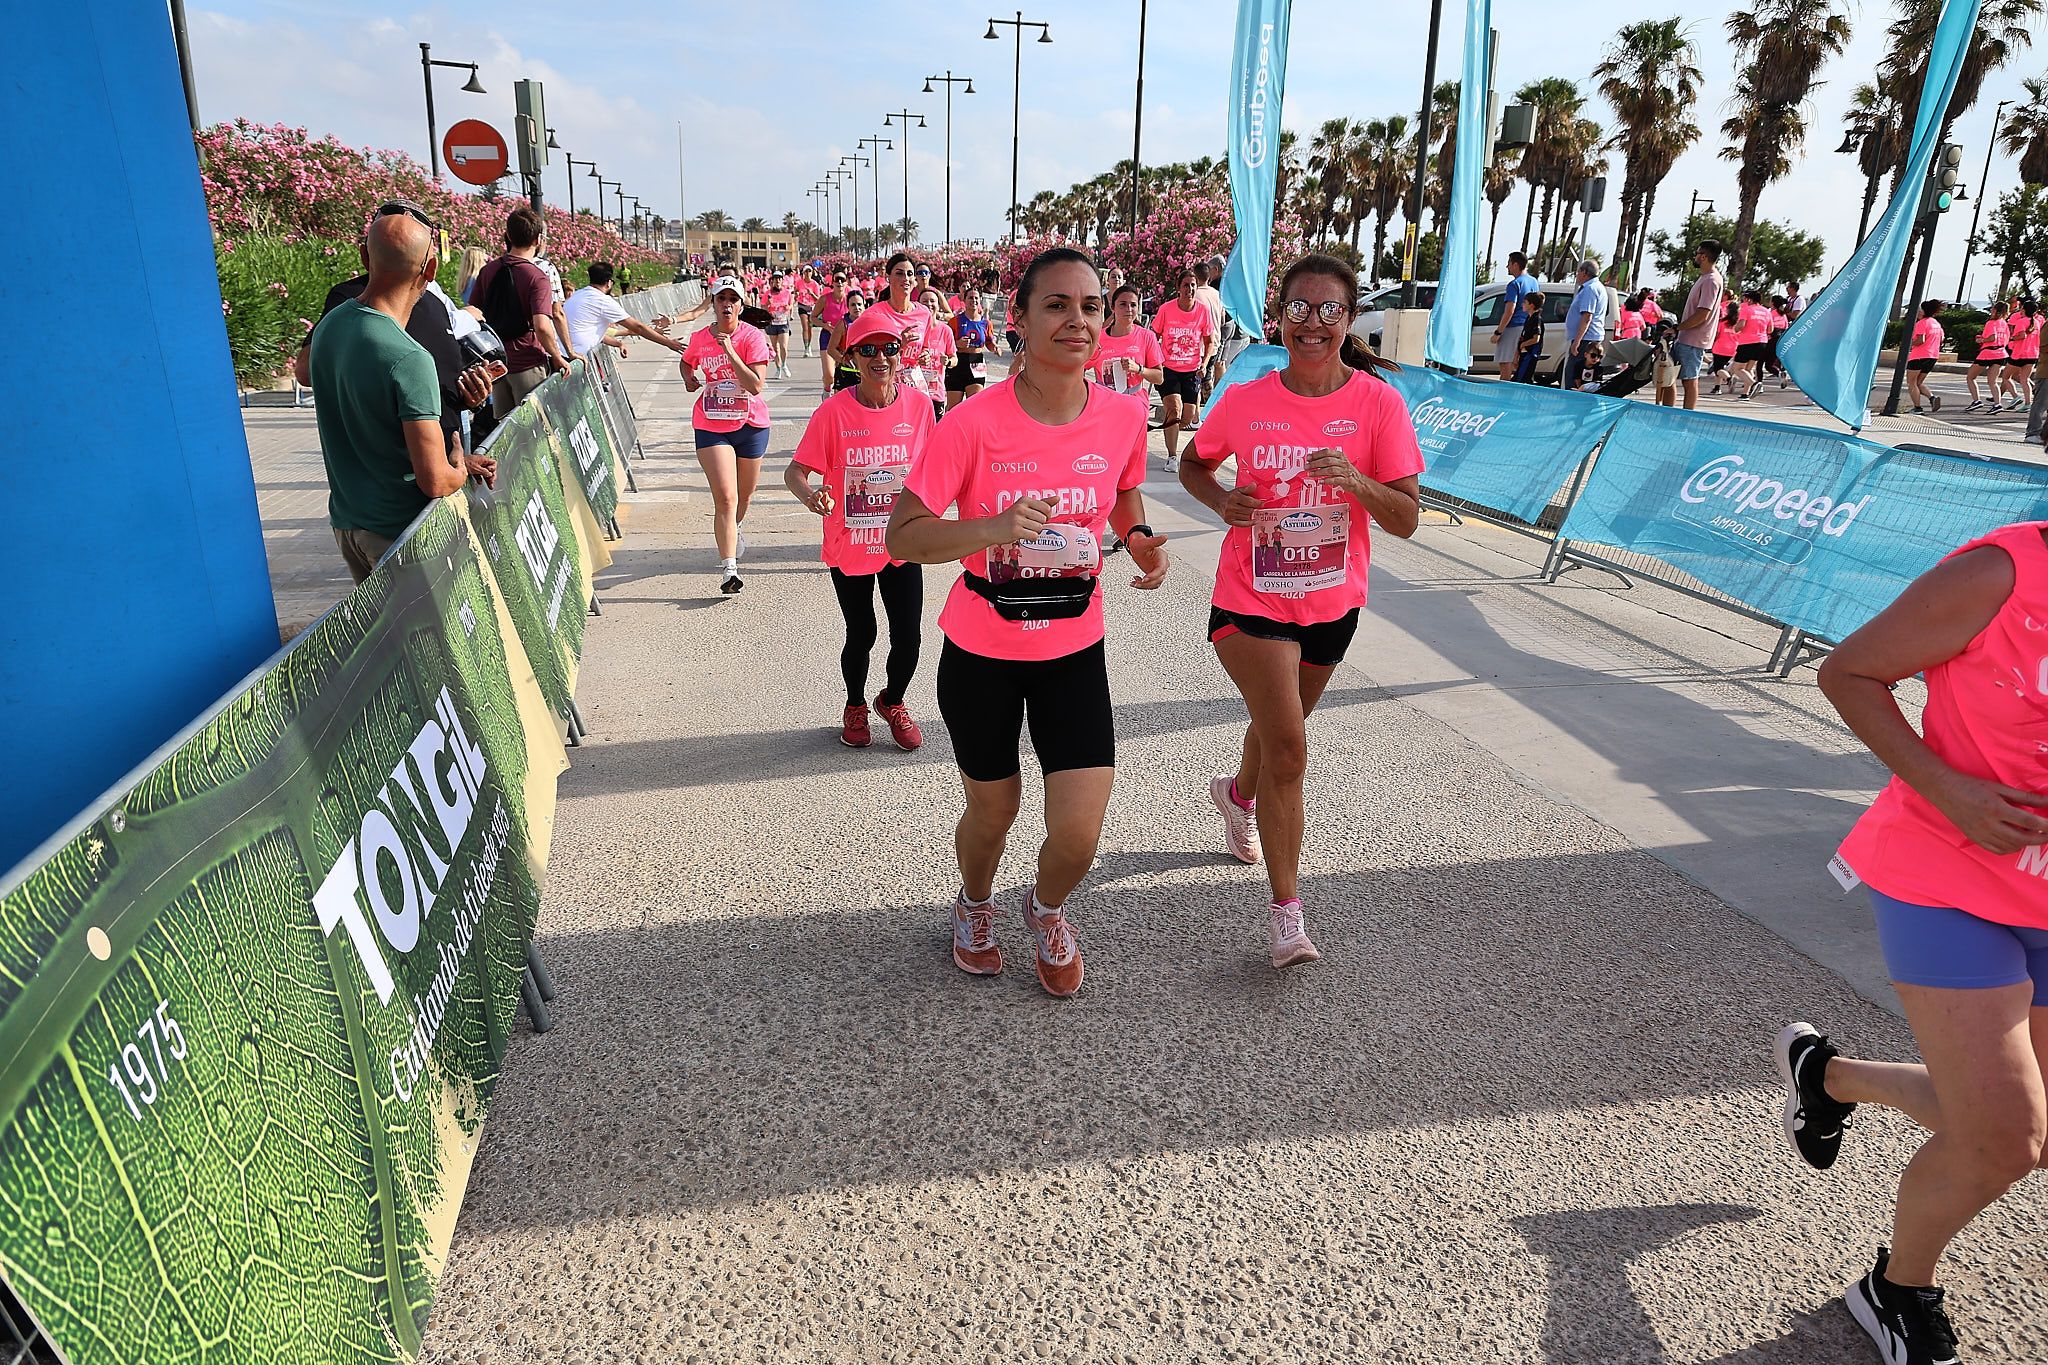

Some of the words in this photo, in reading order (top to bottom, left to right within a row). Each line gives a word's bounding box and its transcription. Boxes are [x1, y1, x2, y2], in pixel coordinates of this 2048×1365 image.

[701, 353, 729, 369] ARRER
[717, 397, 735, 405] 016
[841, 429, 870, 438] OYSHO
[1250, 421, 1291, 431] OYSHO
[1419, 437, 1448, 450] AMPOLLAS
[846, 444, 909, 466] CARRERA
[1252, 444, 1343, 470] CARR
[991, 461, 1038, 473] OYSHO
[867, 494, 892, 505] 016
[1680, 455, 1871, 537] Compeed
[1283, 519, 1320, 528] ASTURIANA
[1709, 514, 1774, 547] AMPOLLAS
[850, 528, 887, 545] MUJ
[866, 546, 884, 555] 2026
[1283, 546, 1320, 561] 016
[1020, 567, 1062, 578] 016
[1318, 565, 1337, 574] VALENCIA
[1312, 576, 1338, 587] Santander
[490, 794, 511, 848] 1975
[470, 830, 502, 905] desde
[462, 877, 482, 926] ti
[451, 906, 473, 957] de
[390, 942, 460, 1103] Cuidando
[108, 999, 188, 1122] 1975
